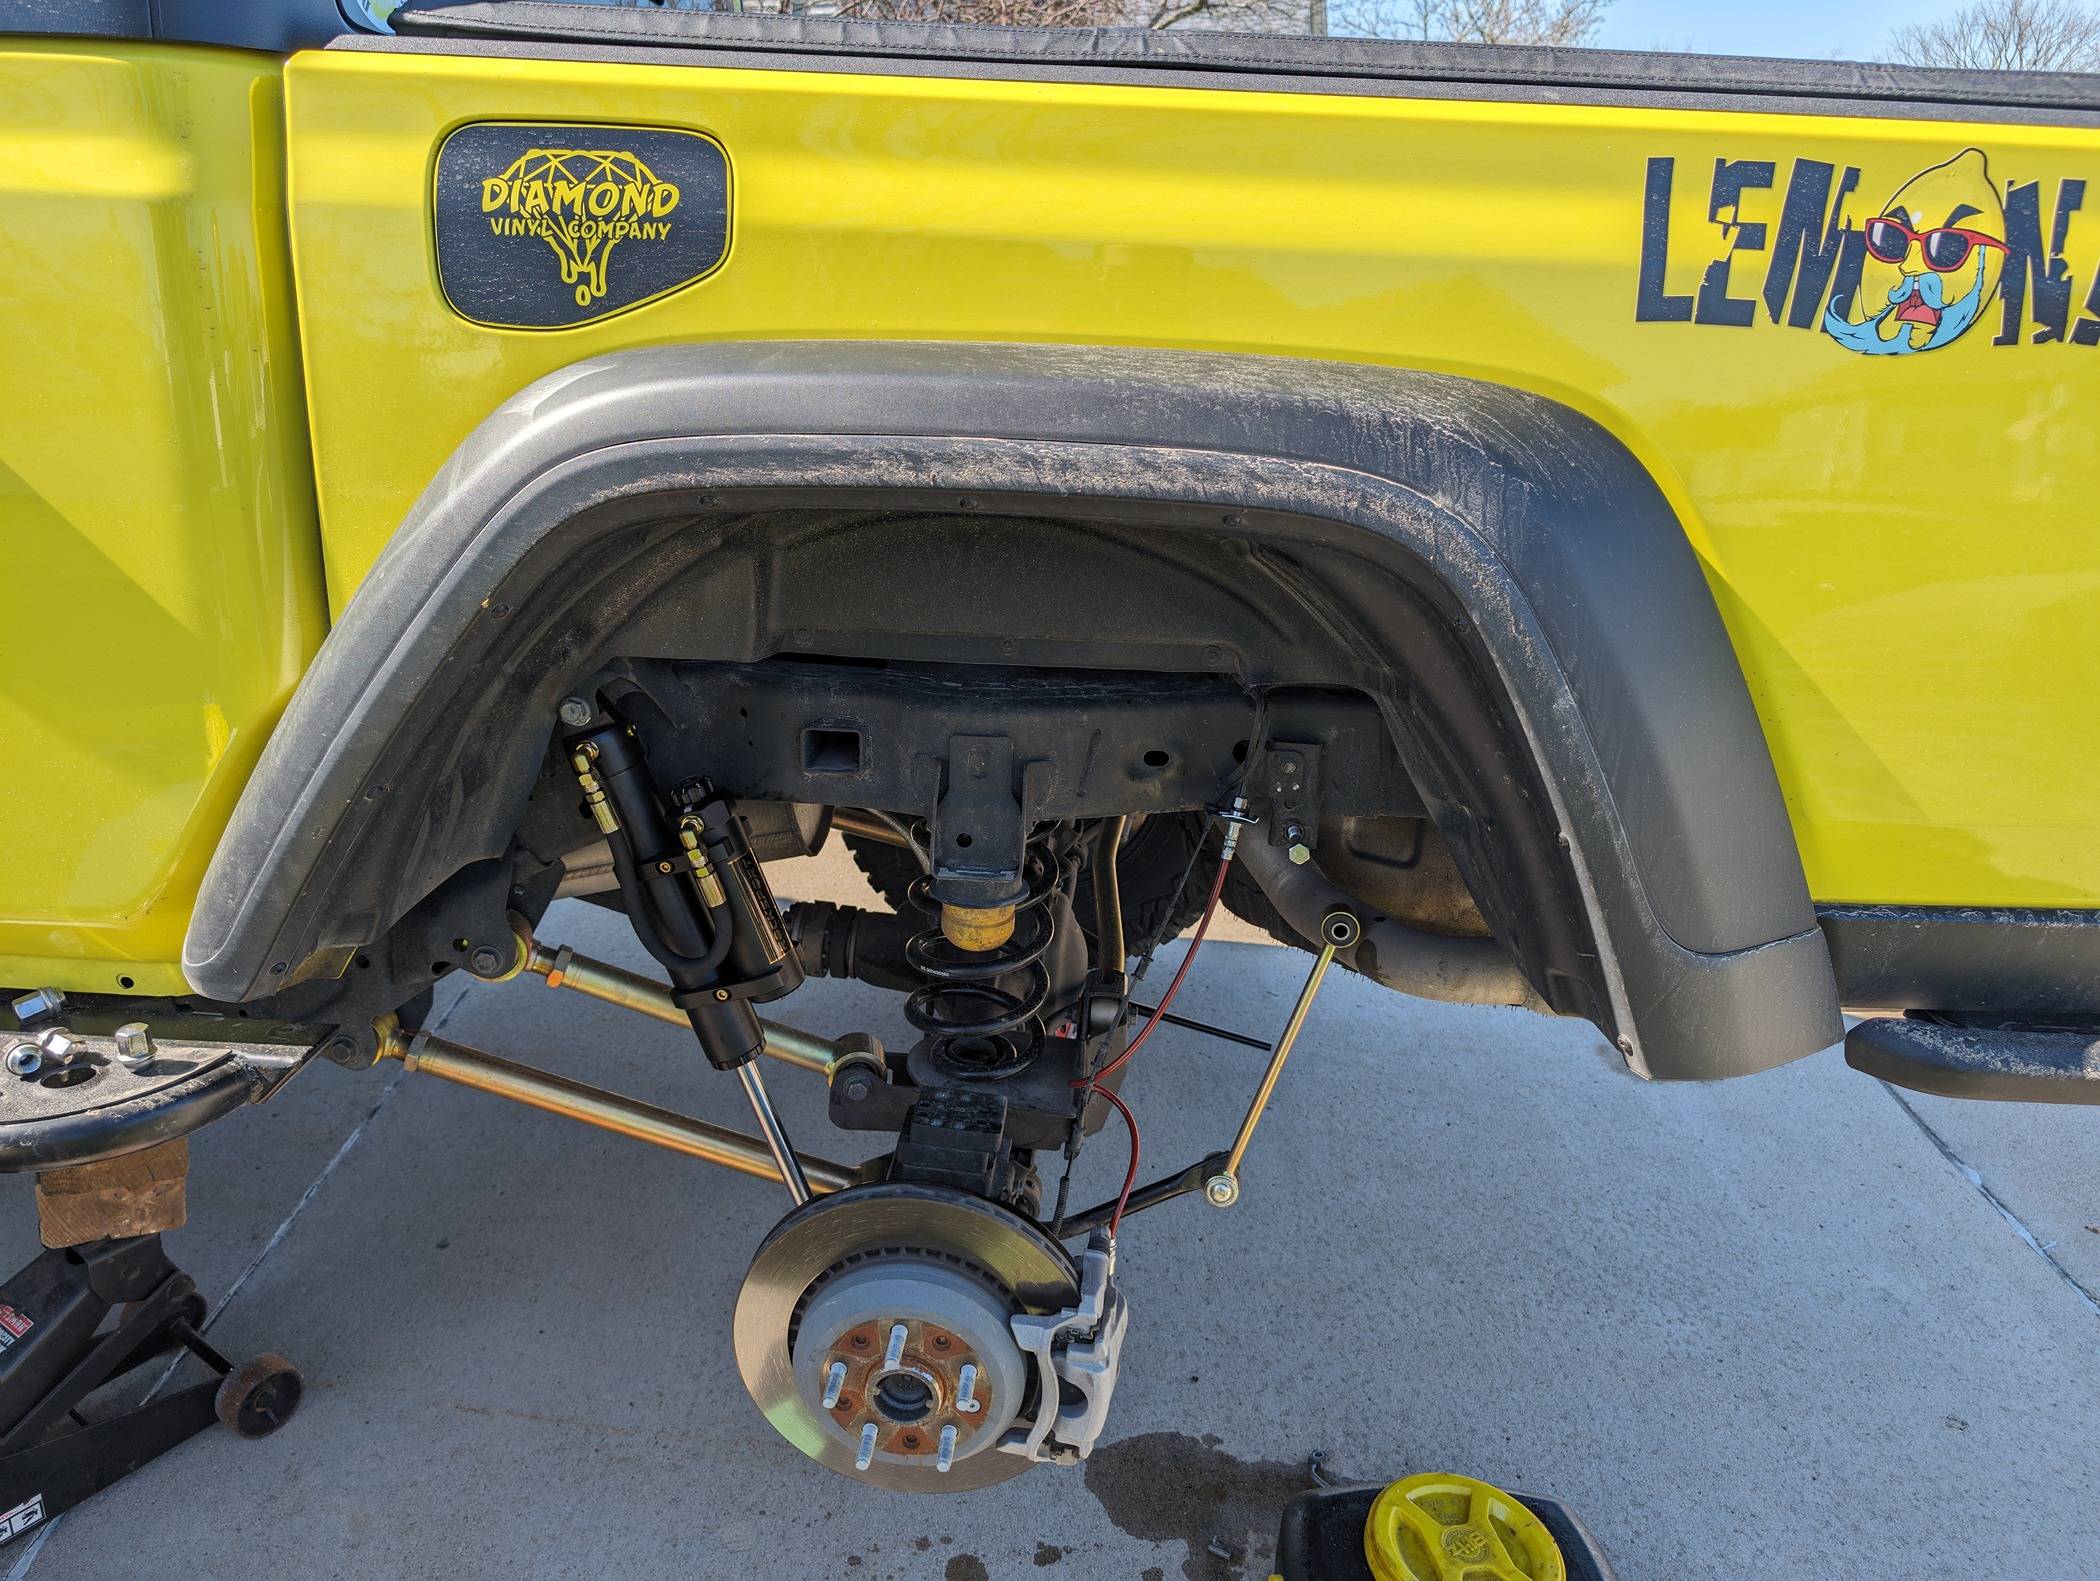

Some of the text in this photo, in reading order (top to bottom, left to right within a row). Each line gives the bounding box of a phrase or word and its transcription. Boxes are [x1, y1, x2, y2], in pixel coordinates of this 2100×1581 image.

[481, 178, 680, 218] DIAMOND
[490, 217, 672, 241] VINYL COMPANY
